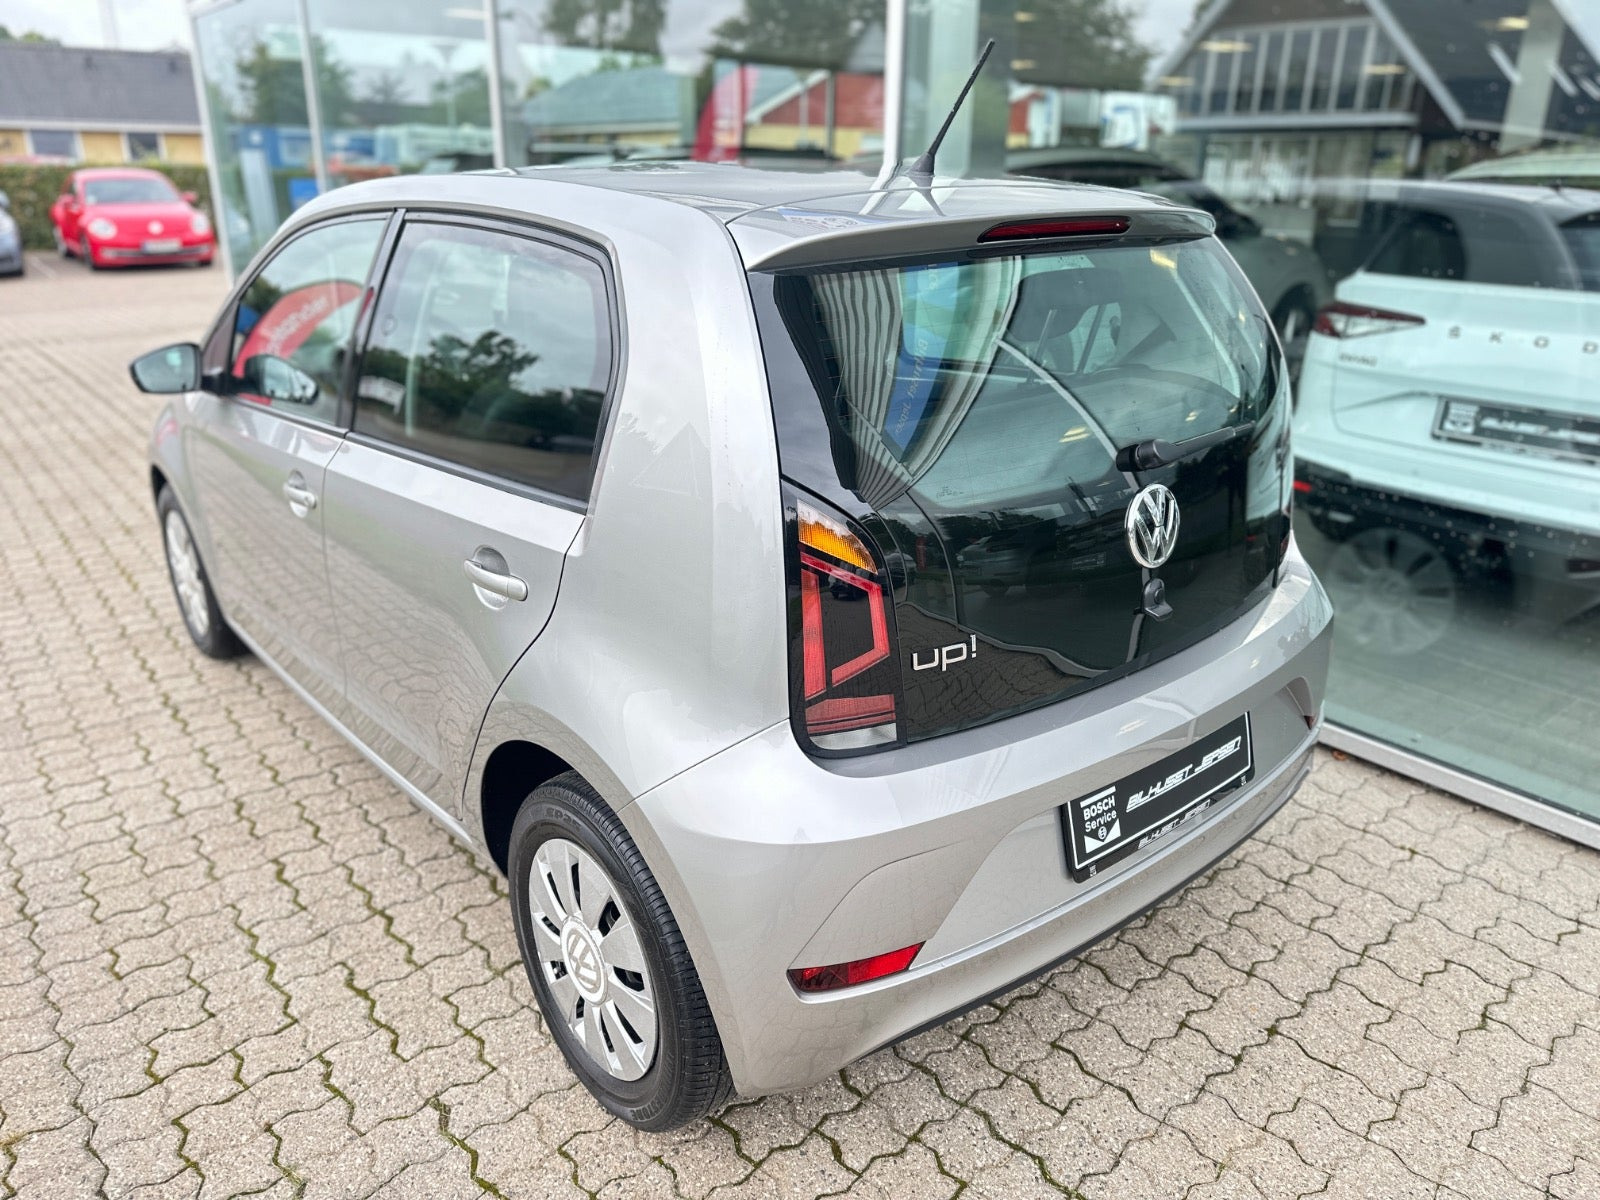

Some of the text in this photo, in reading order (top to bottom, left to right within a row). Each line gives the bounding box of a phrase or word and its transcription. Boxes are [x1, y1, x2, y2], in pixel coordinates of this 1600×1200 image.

[1130, 486, 1177, 566] VW
[912, 634, 977, 672] up!
[1126, 764, 1193, 811] BILHUSET
[1083, 795, 1116, 820] BOSCH
[1085, 811, 1117, 832] Service
